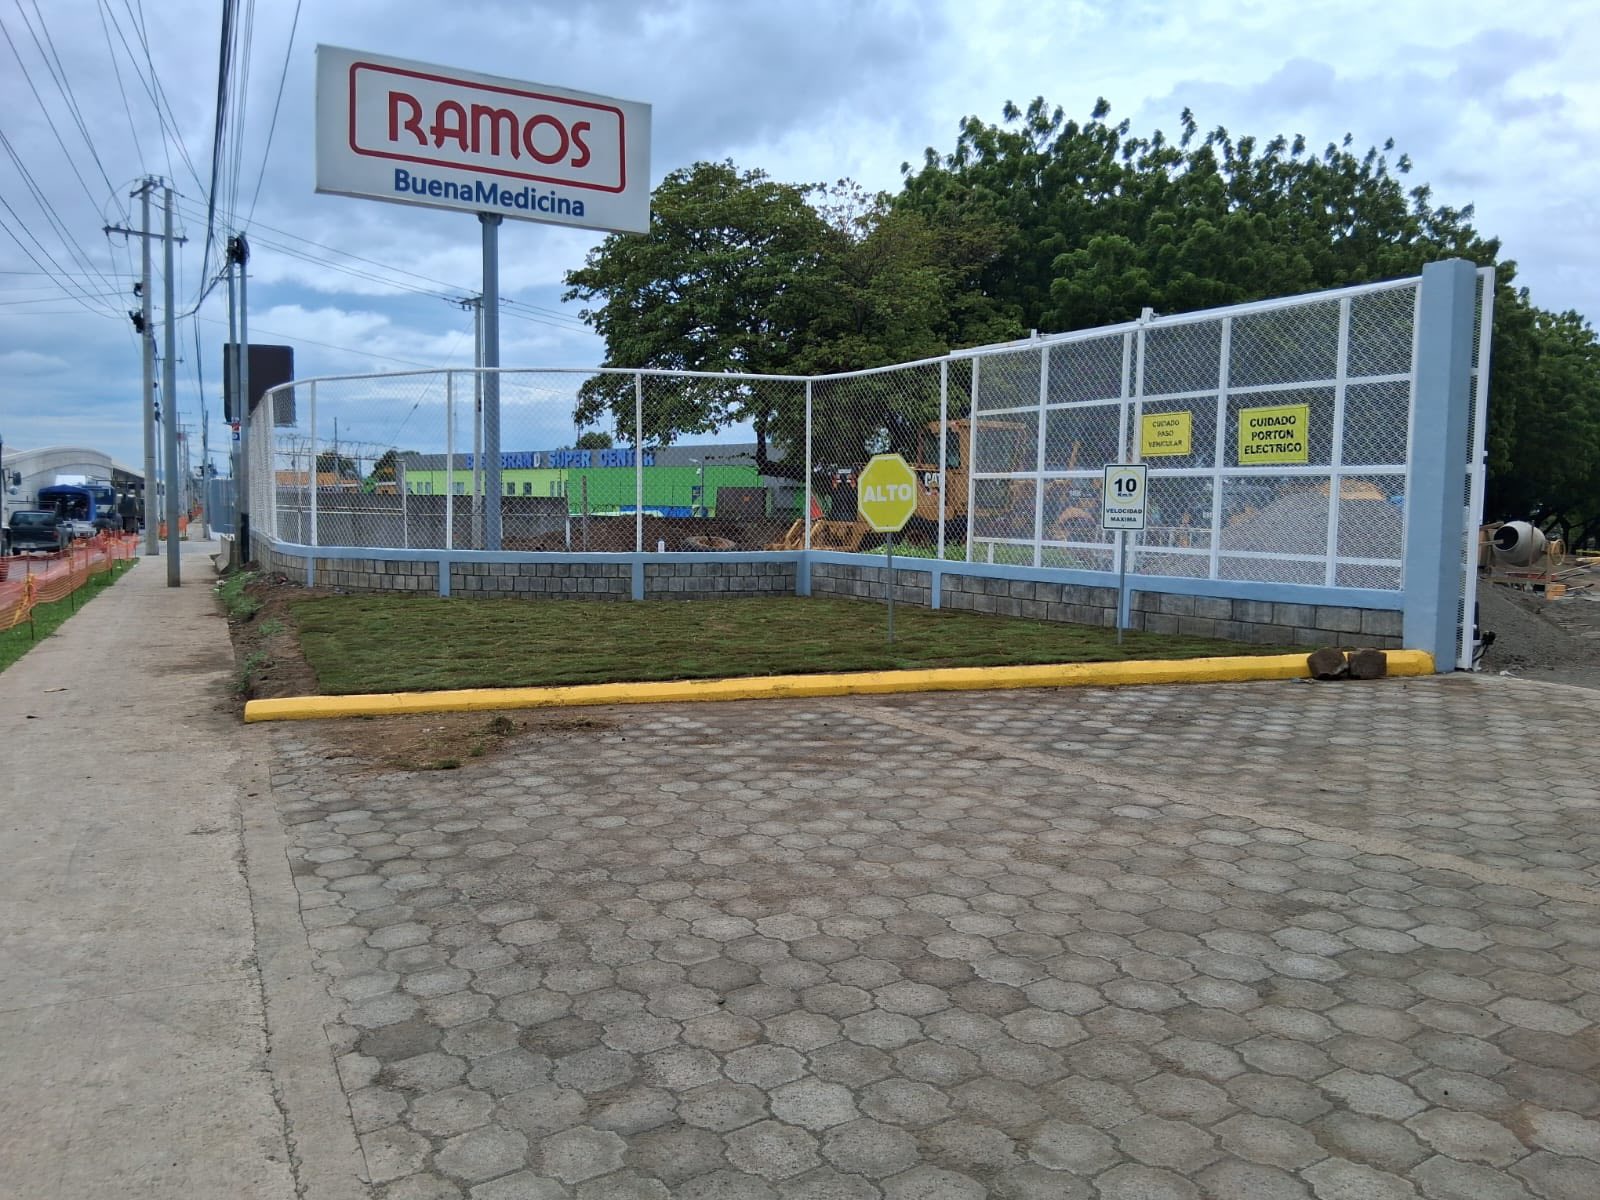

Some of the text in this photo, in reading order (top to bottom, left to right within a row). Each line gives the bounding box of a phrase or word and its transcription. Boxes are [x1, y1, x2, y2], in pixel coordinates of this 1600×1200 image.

[388, 91, 591, 168] RAMOS
[394, 168, 585, 217] BuenaMedicina
[1152, 419, 1180, 428] CUIDADO
[1250, 415, 1296, 428] CUIDADO
[1251, 429, 1294, 441] PORTON
[1244, 442, 1302, 455] ELECTRICO
[549, 450, 591, 468] SUPER
[600, 448, 655, 467] CENTR
[863, 484, 912, 502] ALTO
[1114, 478, 1137, 493] 10
